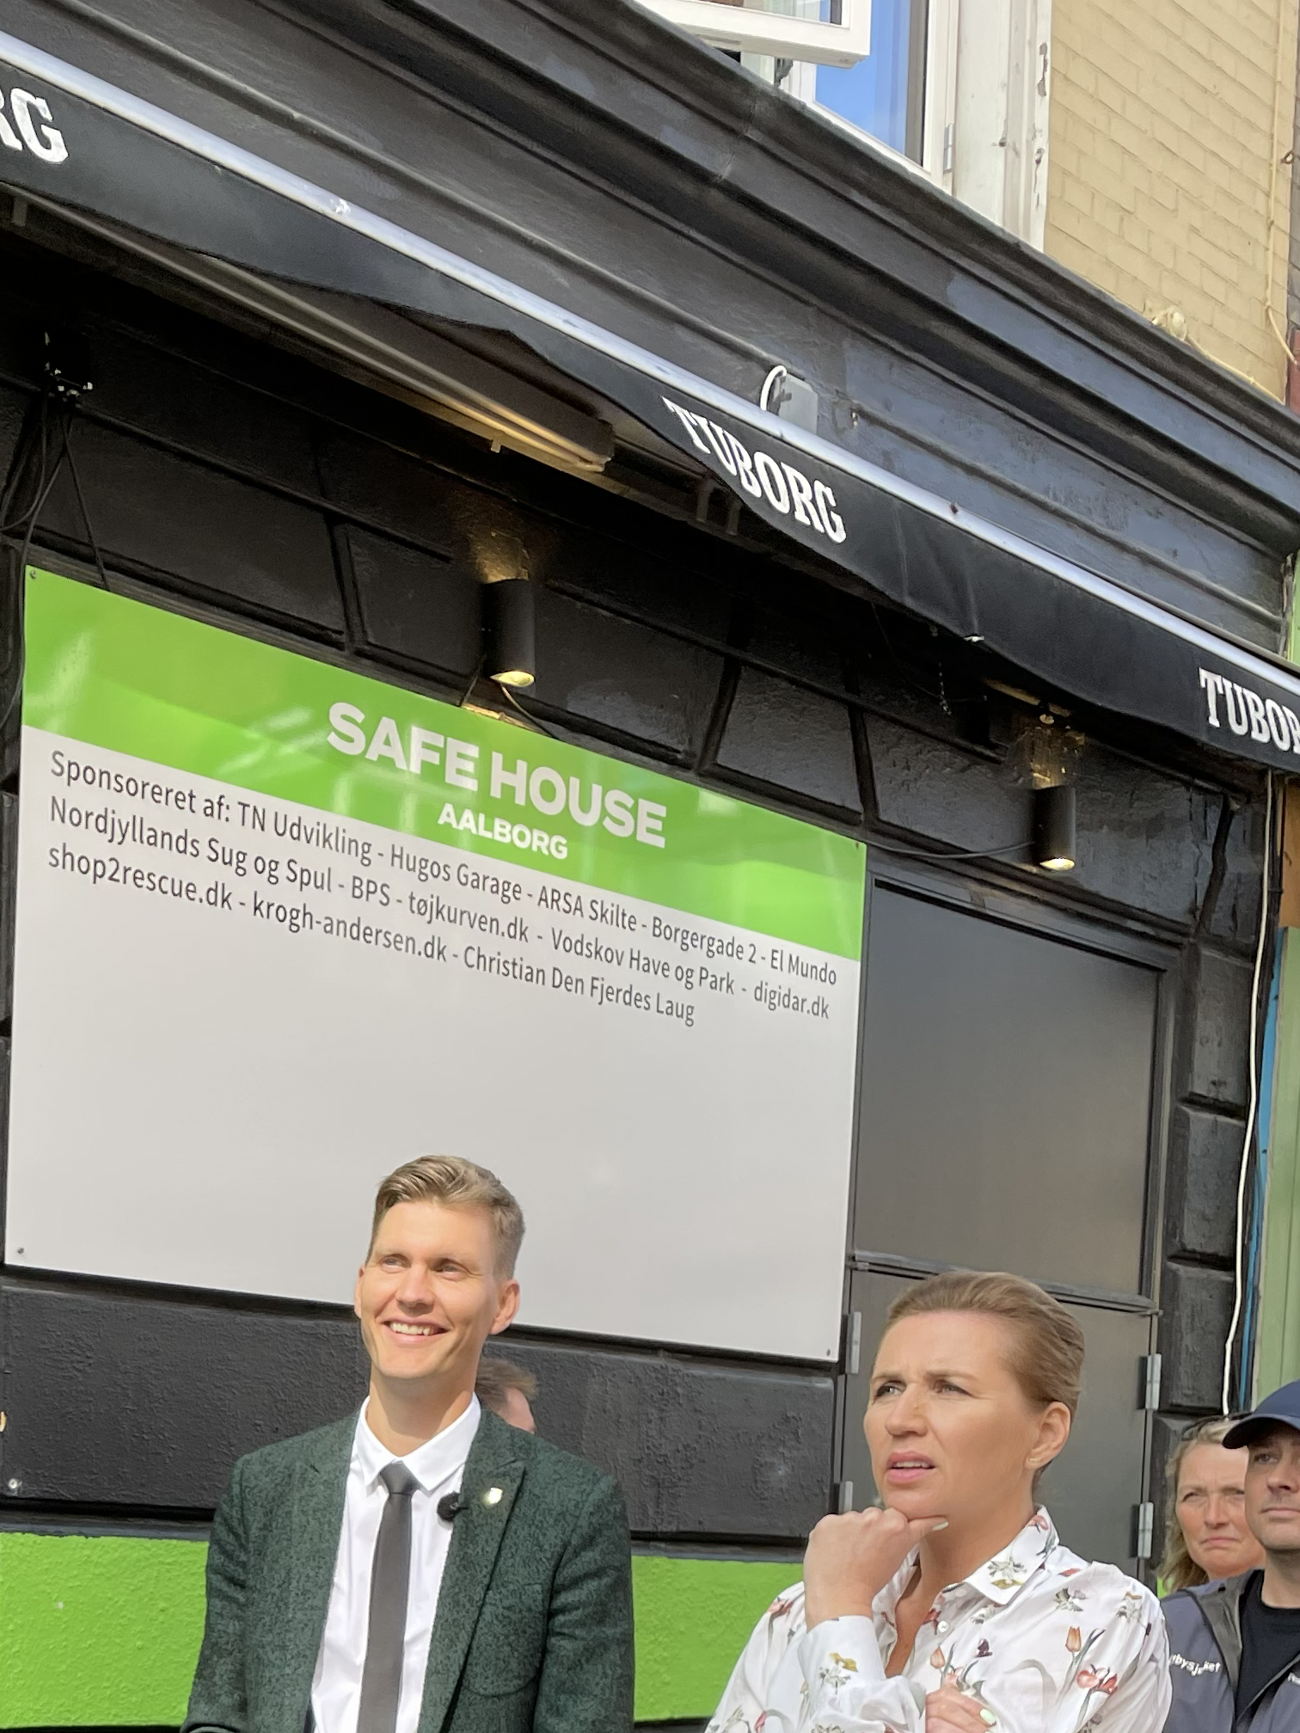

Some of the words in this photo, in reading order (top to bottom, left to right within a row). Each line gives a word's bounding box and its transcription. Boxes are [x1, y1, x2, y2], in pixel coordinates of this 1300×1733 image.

[661, 395, 847, 543] TUBORG
[327, 702, 480, 791] SAFE
[490, 751, 667, 848] HOUSE
[438, 803, 568, 859] AALBORG
[49, 844, 233, 911] shop2rescue.dk
[253, 891, 447, 962] krogh-andersen.dk
[464, 945, 546, 985] Christian
[552, 967, 585, 995] Den
[590, 976, 651, 1010] Fjerdes
[656, 993, 695, 1027] Laug
[50, 795, 200, 858] Nordjyllands
[207, 837, 247, 877] Sug
[254, 855, 279, 885] og
[286, 859, 332, 893] Spul
[352, 875, 390, 907] BPS
[409, 890, 529, 943] tøjkurven.dk
[552, 927, 625, 967] Vodskov
[629, 949, 670, 978] Have
[675, 967, 694, 990] og
[699, 967, 734, 995] Park
[753, 980, 829, 1019] digidar.dk
[51, 750, 196, 813] Sponsoreret
[203, 795, 230, 823] af:
[238, 802, 266, 832] TN
[274, 811, 372, 867] Udvikling
[390, 844, 451, 882] Hugos
[457, 863, 522, 904] Garage
[538, 885, 584, 918] ARSA
[589, 899, 637, 932] Skilte
[652, 916, 744, 959] Borgergade
[749, 943, 757, 964] 2
[771, 949, 784, 973] El
[788, 954, 837, 986] Mundo
